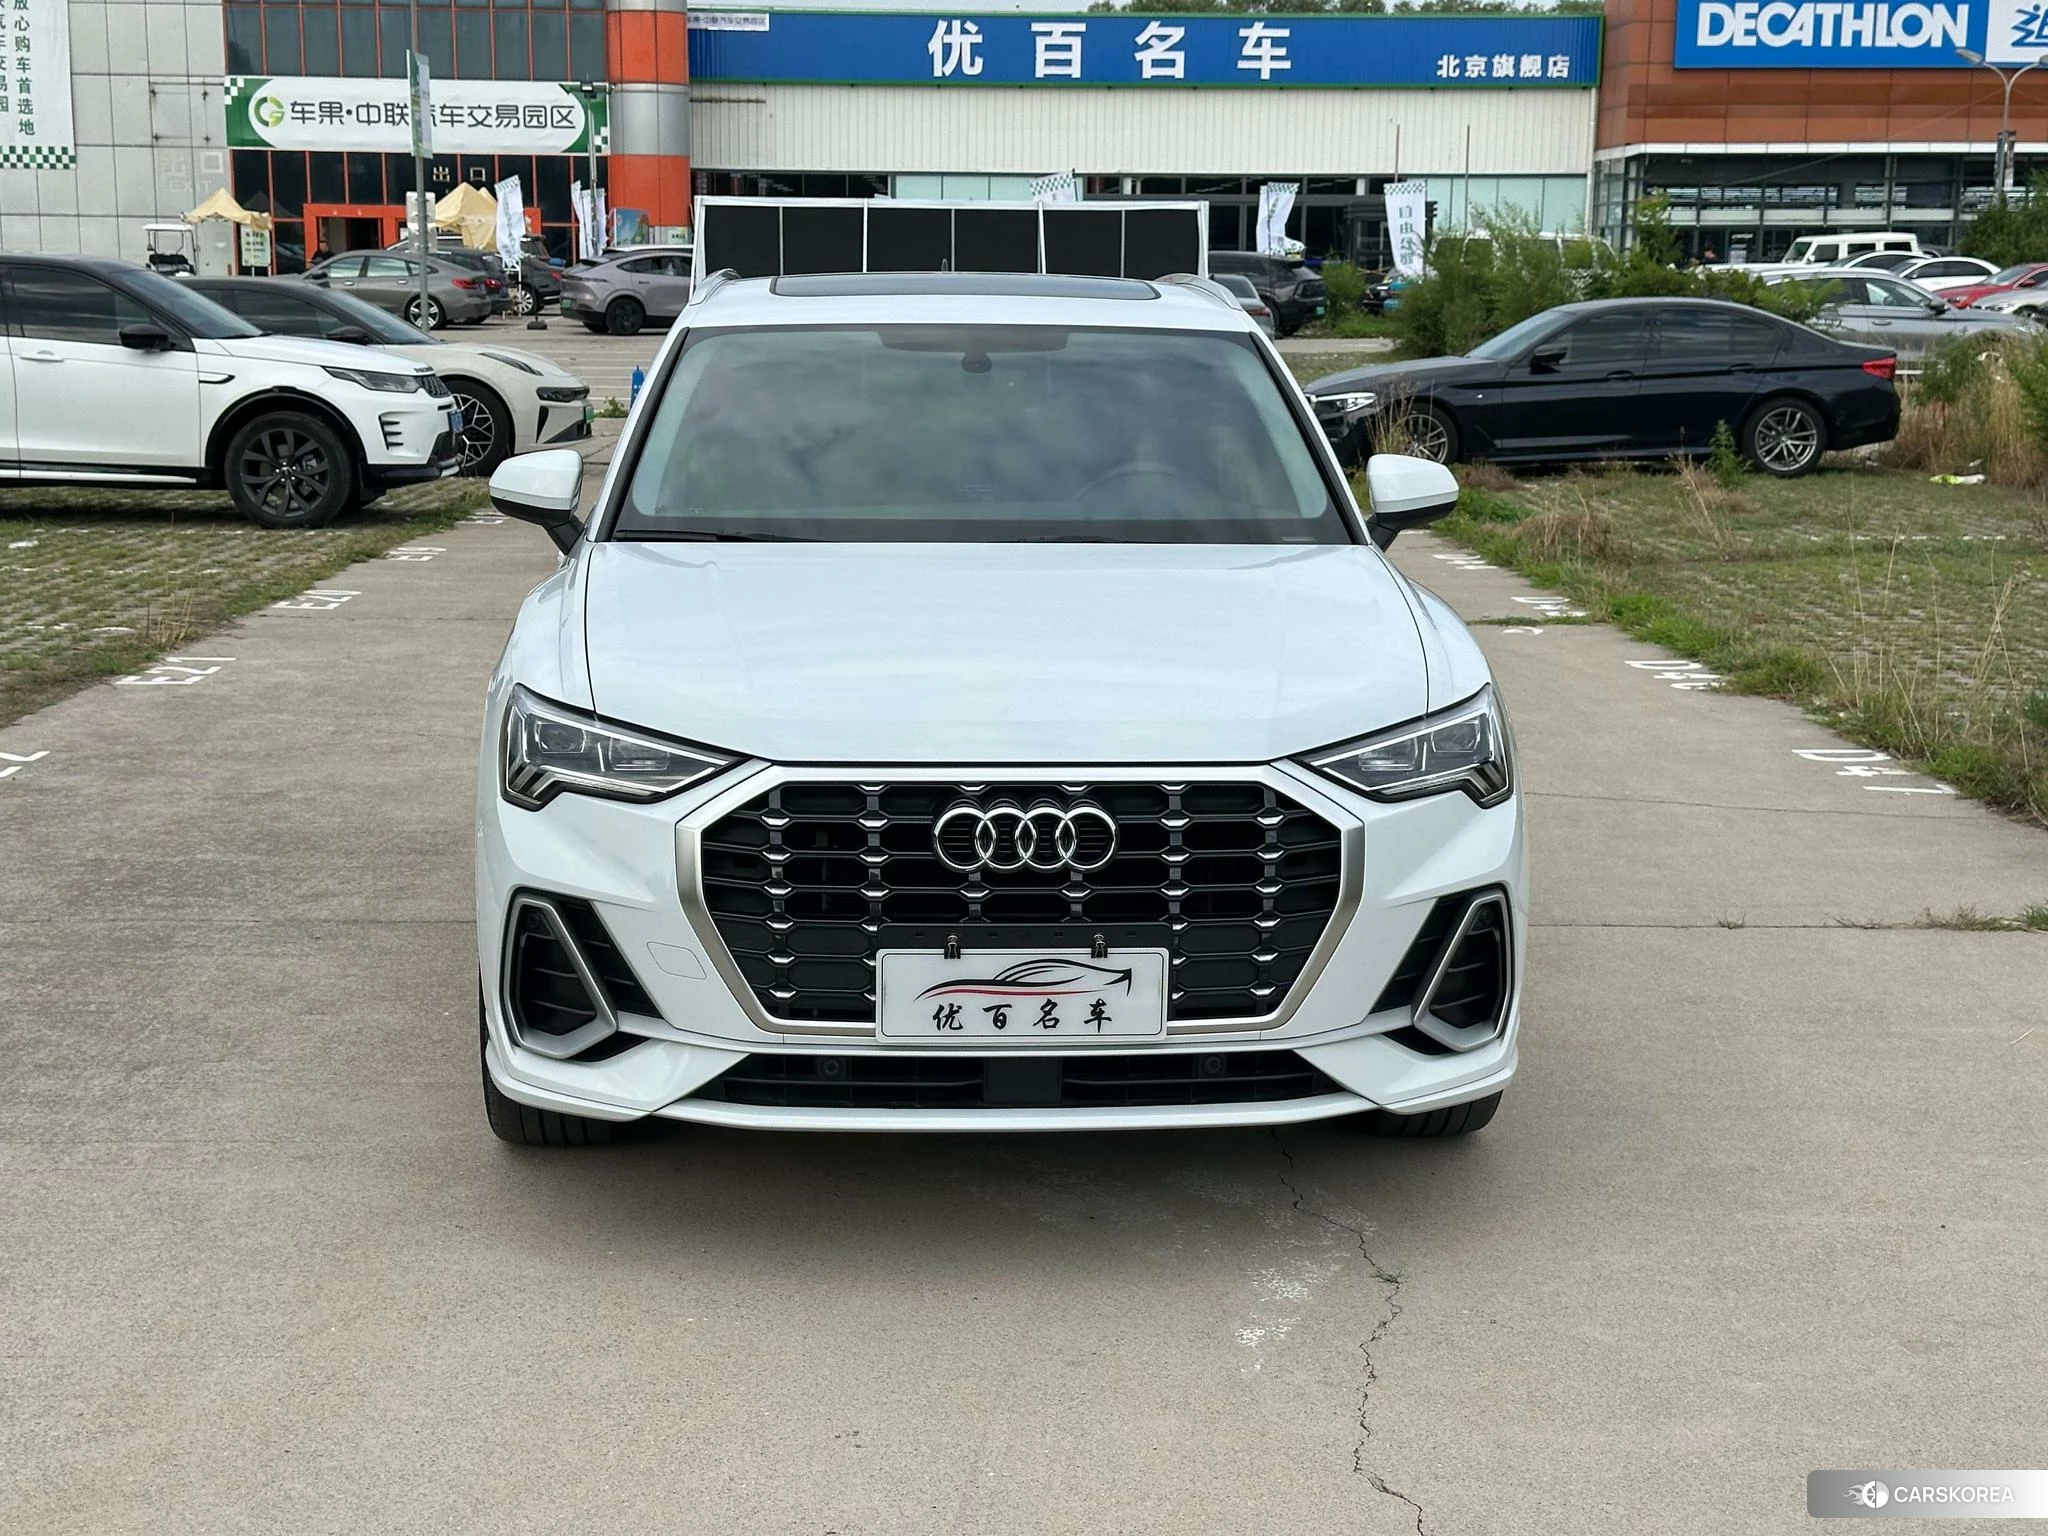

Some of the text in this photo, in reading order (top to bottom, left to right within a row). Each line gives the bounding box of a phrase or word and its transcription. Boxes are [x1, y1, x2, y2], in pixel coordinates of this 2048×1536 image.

[1696, 2, 1969, 48] DECATHLON
[927, 19, 1292, 80] 优百名车
[1436, 53, 1571, 79] 北京旗舰店
[290, 100, 576, 130] 车果·中联车交易园区
[433, 166, 486, 183] 出口
[271, 588, 362, 611] E20
[115, 656, 238, 686] E21
[932, 998, 1112, 1033] 优百名车
